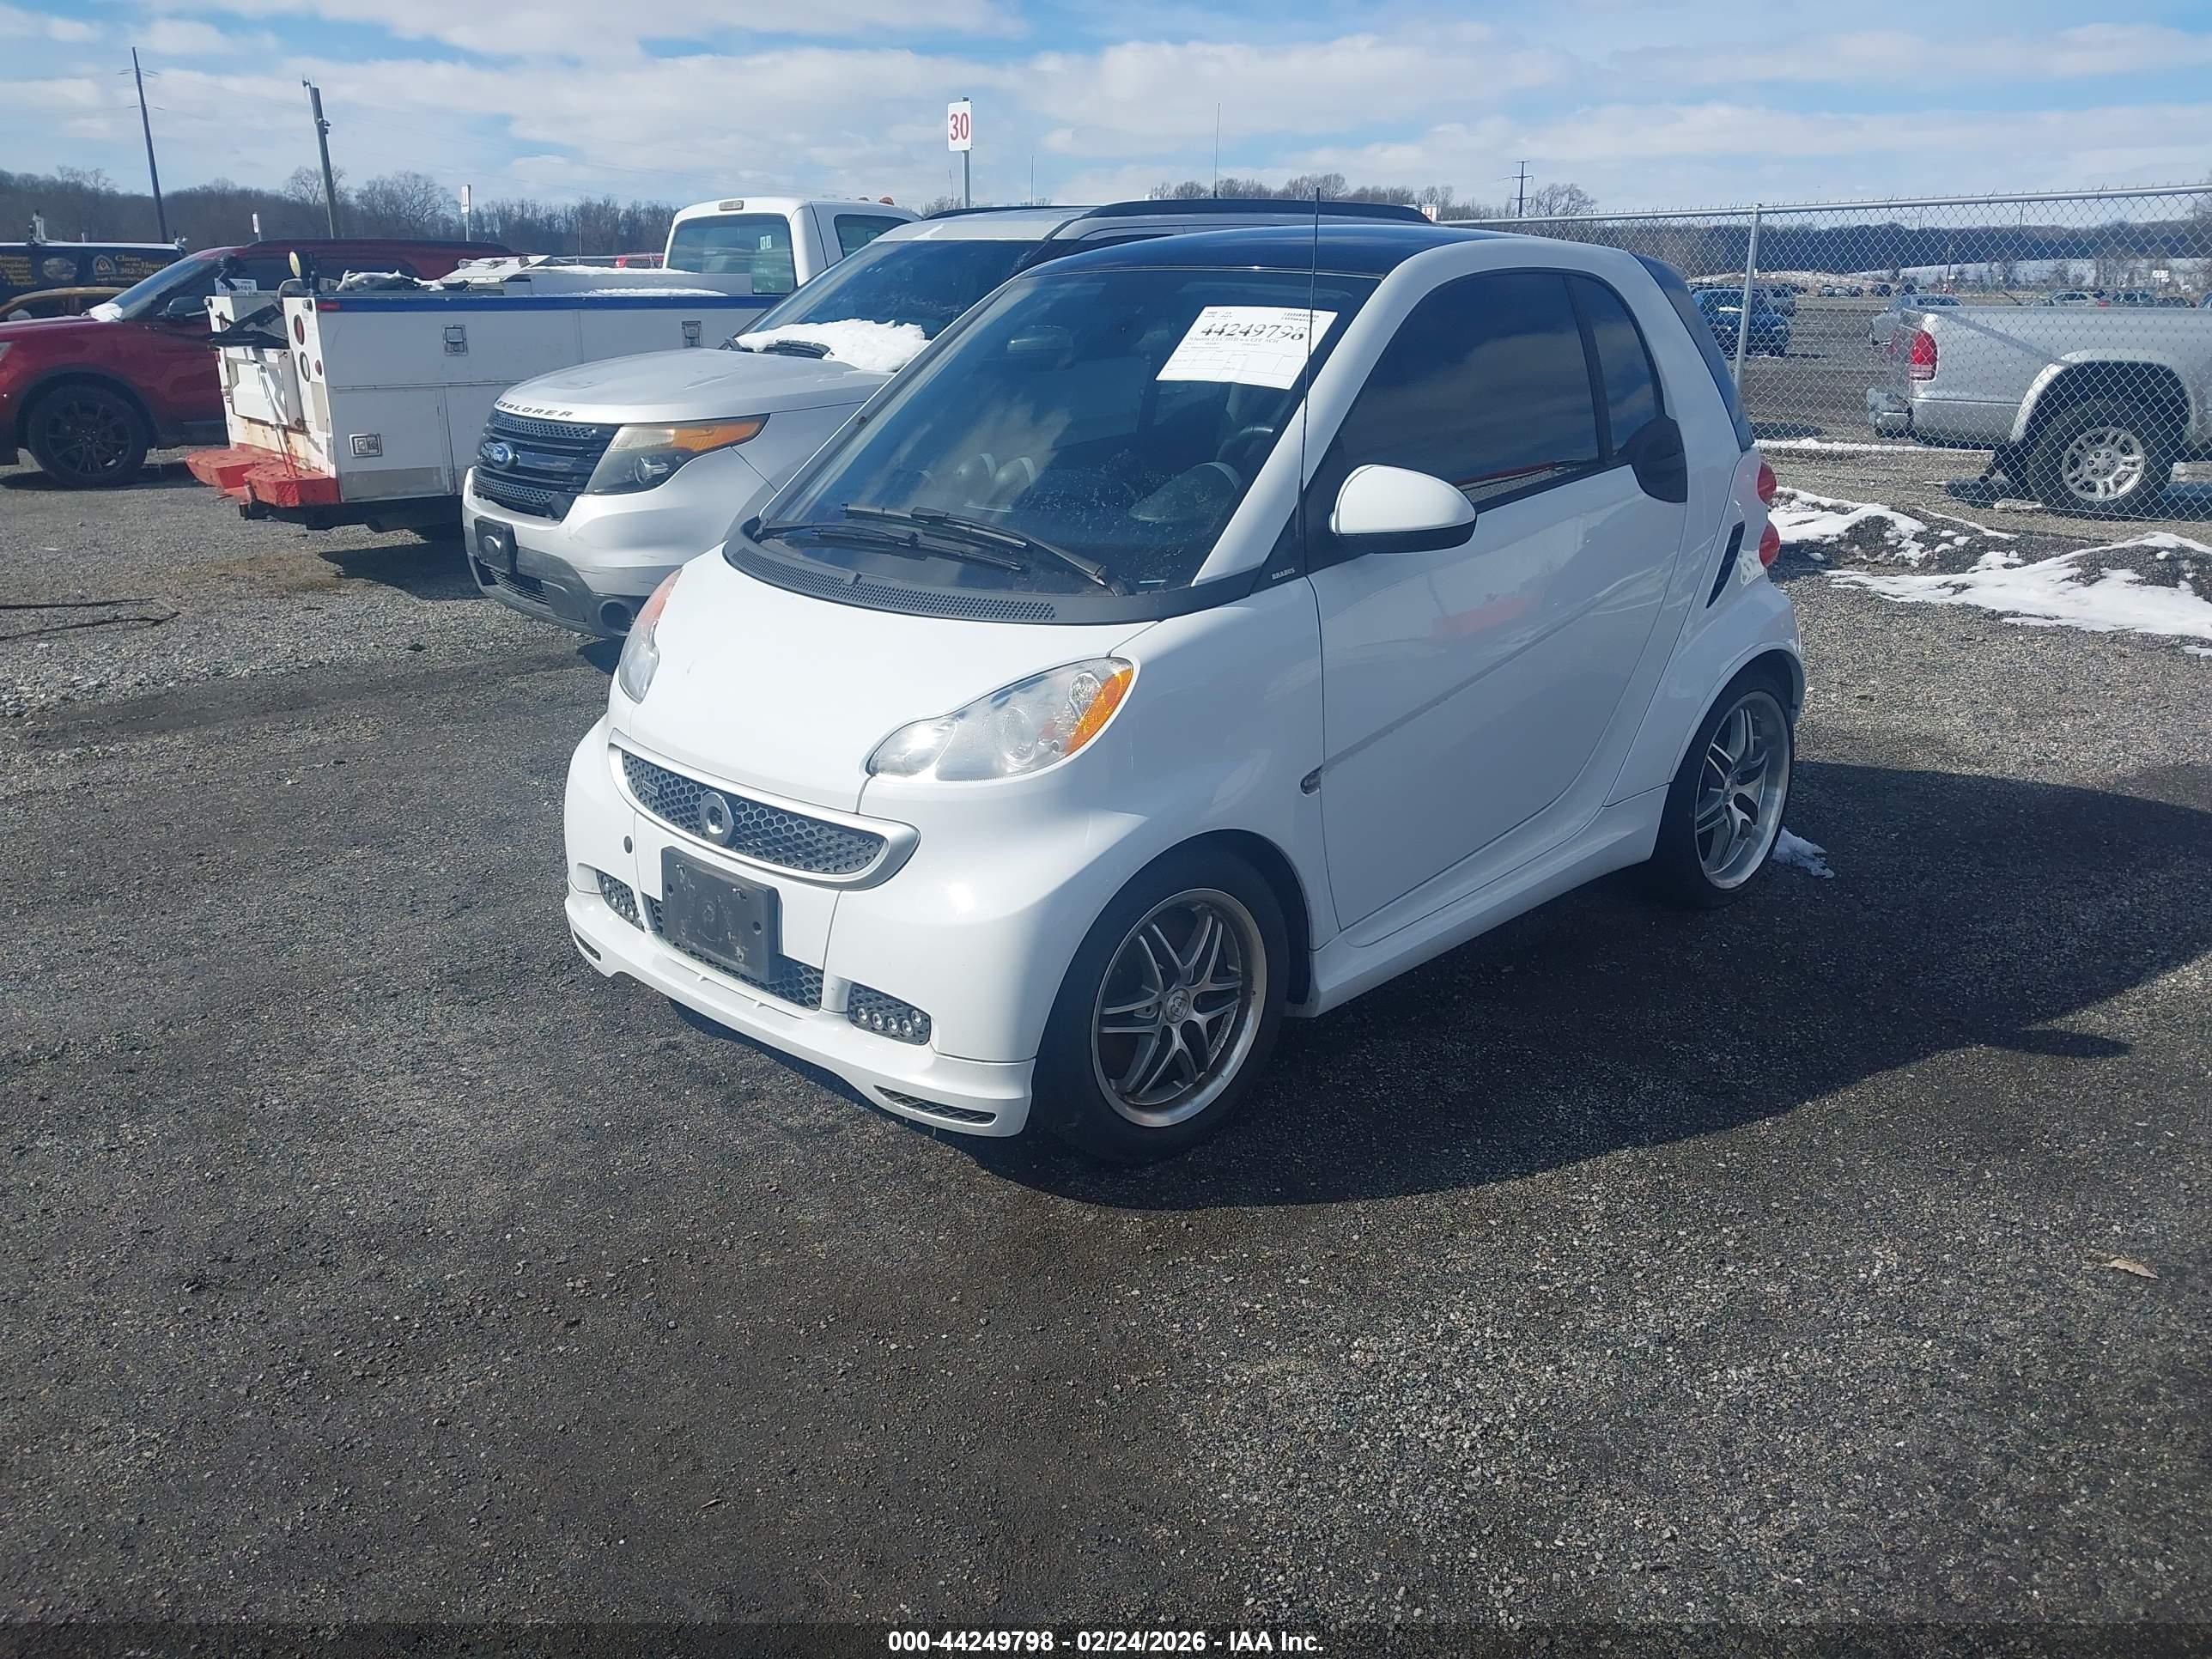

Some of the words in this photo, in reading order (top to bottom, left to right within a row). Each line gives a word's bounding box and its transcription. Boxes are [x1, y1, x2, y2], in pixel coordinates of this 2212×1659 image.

[950, 112, 969, 141] 30
[1201, 323, 1307, 341] 44249798
[496, 400, 573, 417] EXPLORER
